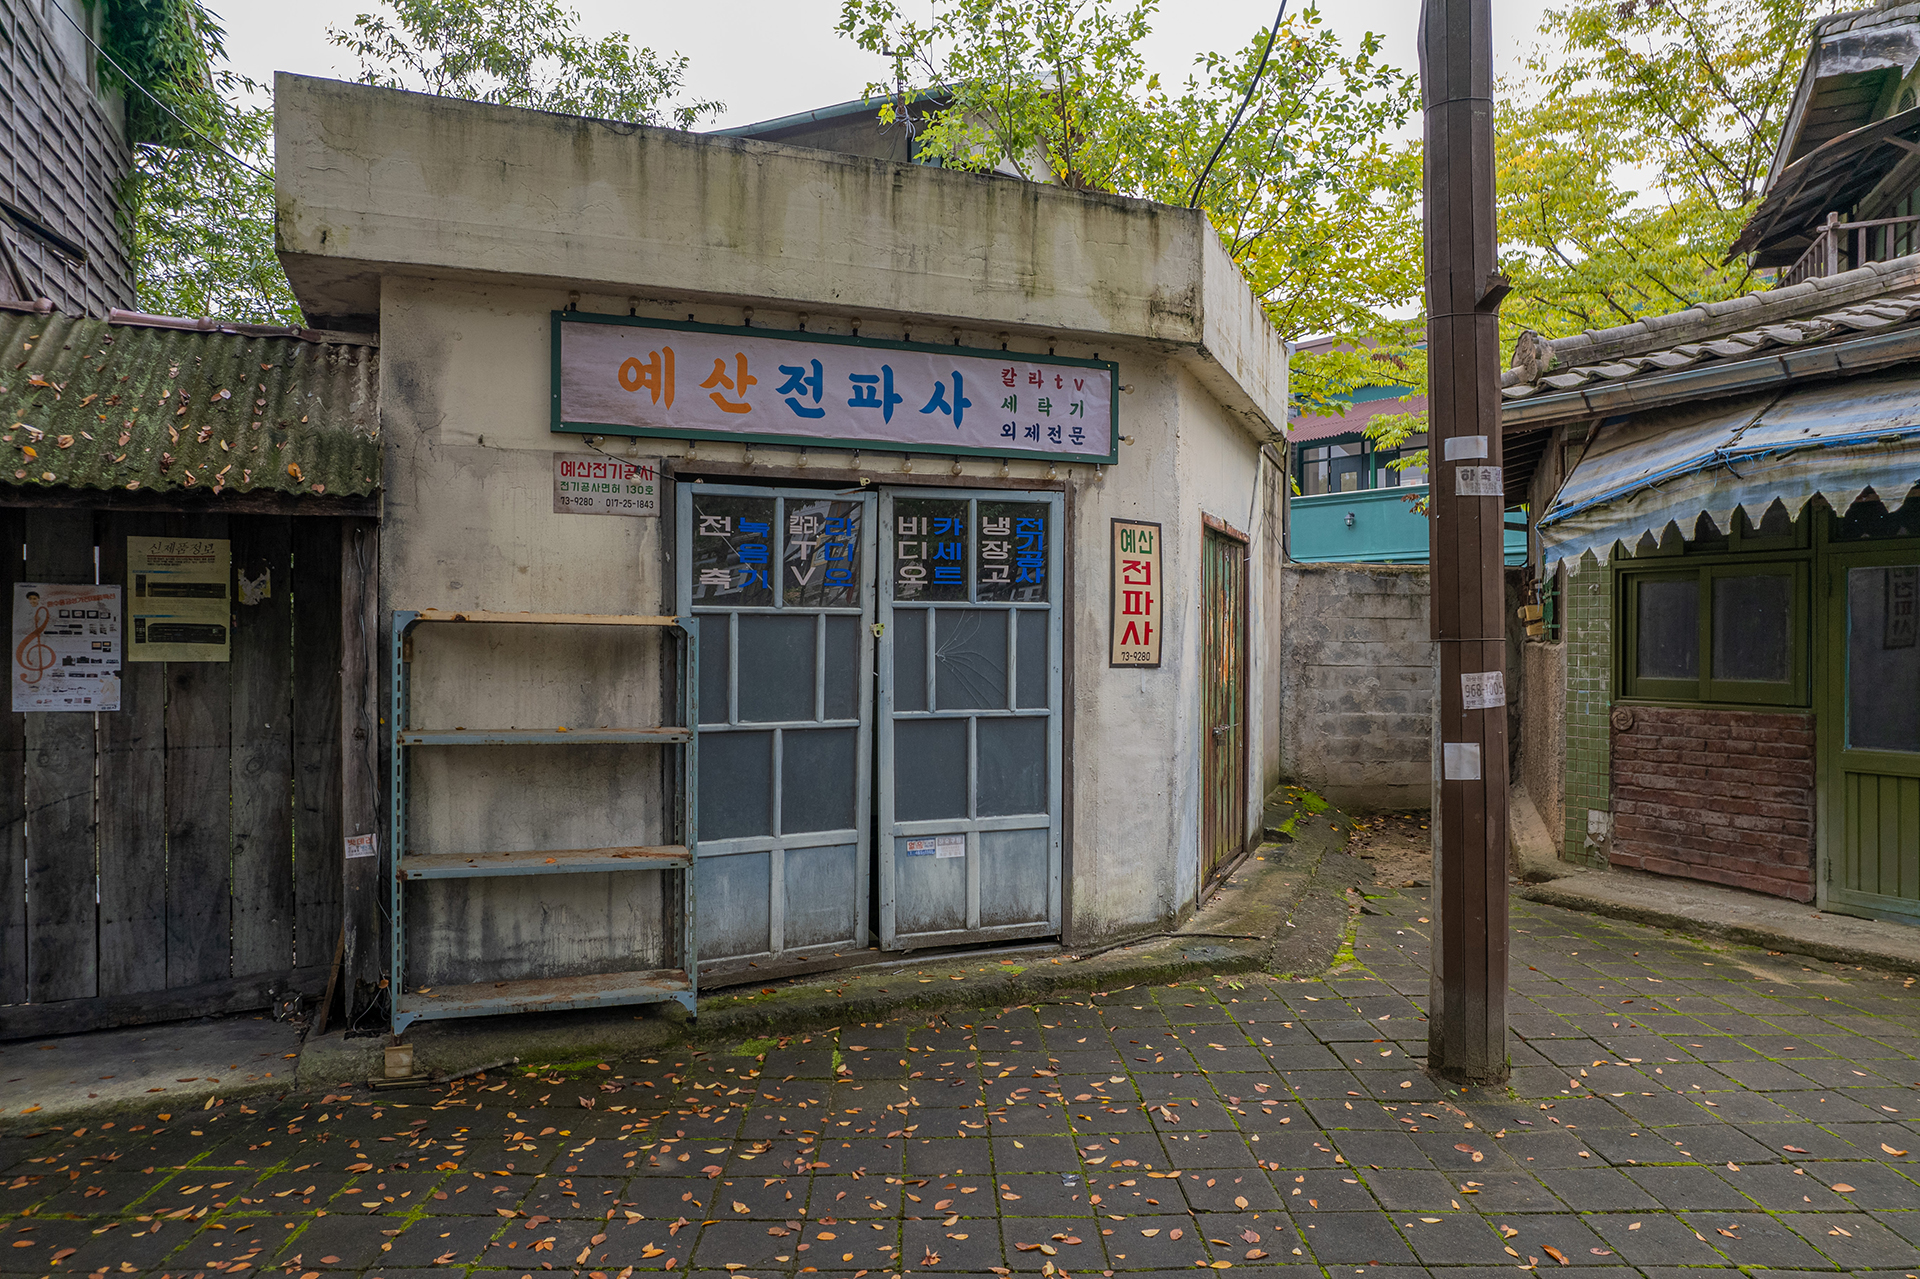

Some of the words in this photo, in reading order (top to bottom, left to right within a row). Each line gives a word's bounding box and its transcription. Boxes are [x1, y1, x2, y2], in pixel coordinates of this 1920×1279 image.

[617, 345, 758, 414] 예산
[775, 358, 973, 430] 전파사
[1000, 393, 1084, 419] 세탁기
[1000, 420, 1086, 446] 외제전문
[560, 481, 621, 494] 전기공사면허
[626, 485, 654, 496] 130호
[560, 496, 594, 507] 73-9280
[605, 498, 654, 509] 017-25-1843
[149, 541, 190, 555] 신제품
[699, 515, 732, 589] 전축
[737, 517, 770, 589] 녹음기
[823, 517, 856, 588] 라디오
[897, 516, 929, 585] 비디오
[933, 517, 964, 585] 카세트
[981, 516, 1012, 584] 냉장고
[1015, 518, 1045, 584] 전기공사
[1120, 528, 1154, 555] 예산
[1120, 559, 1154, 646] 전파사
[1120, 651, 1151, 662] 73-9280
